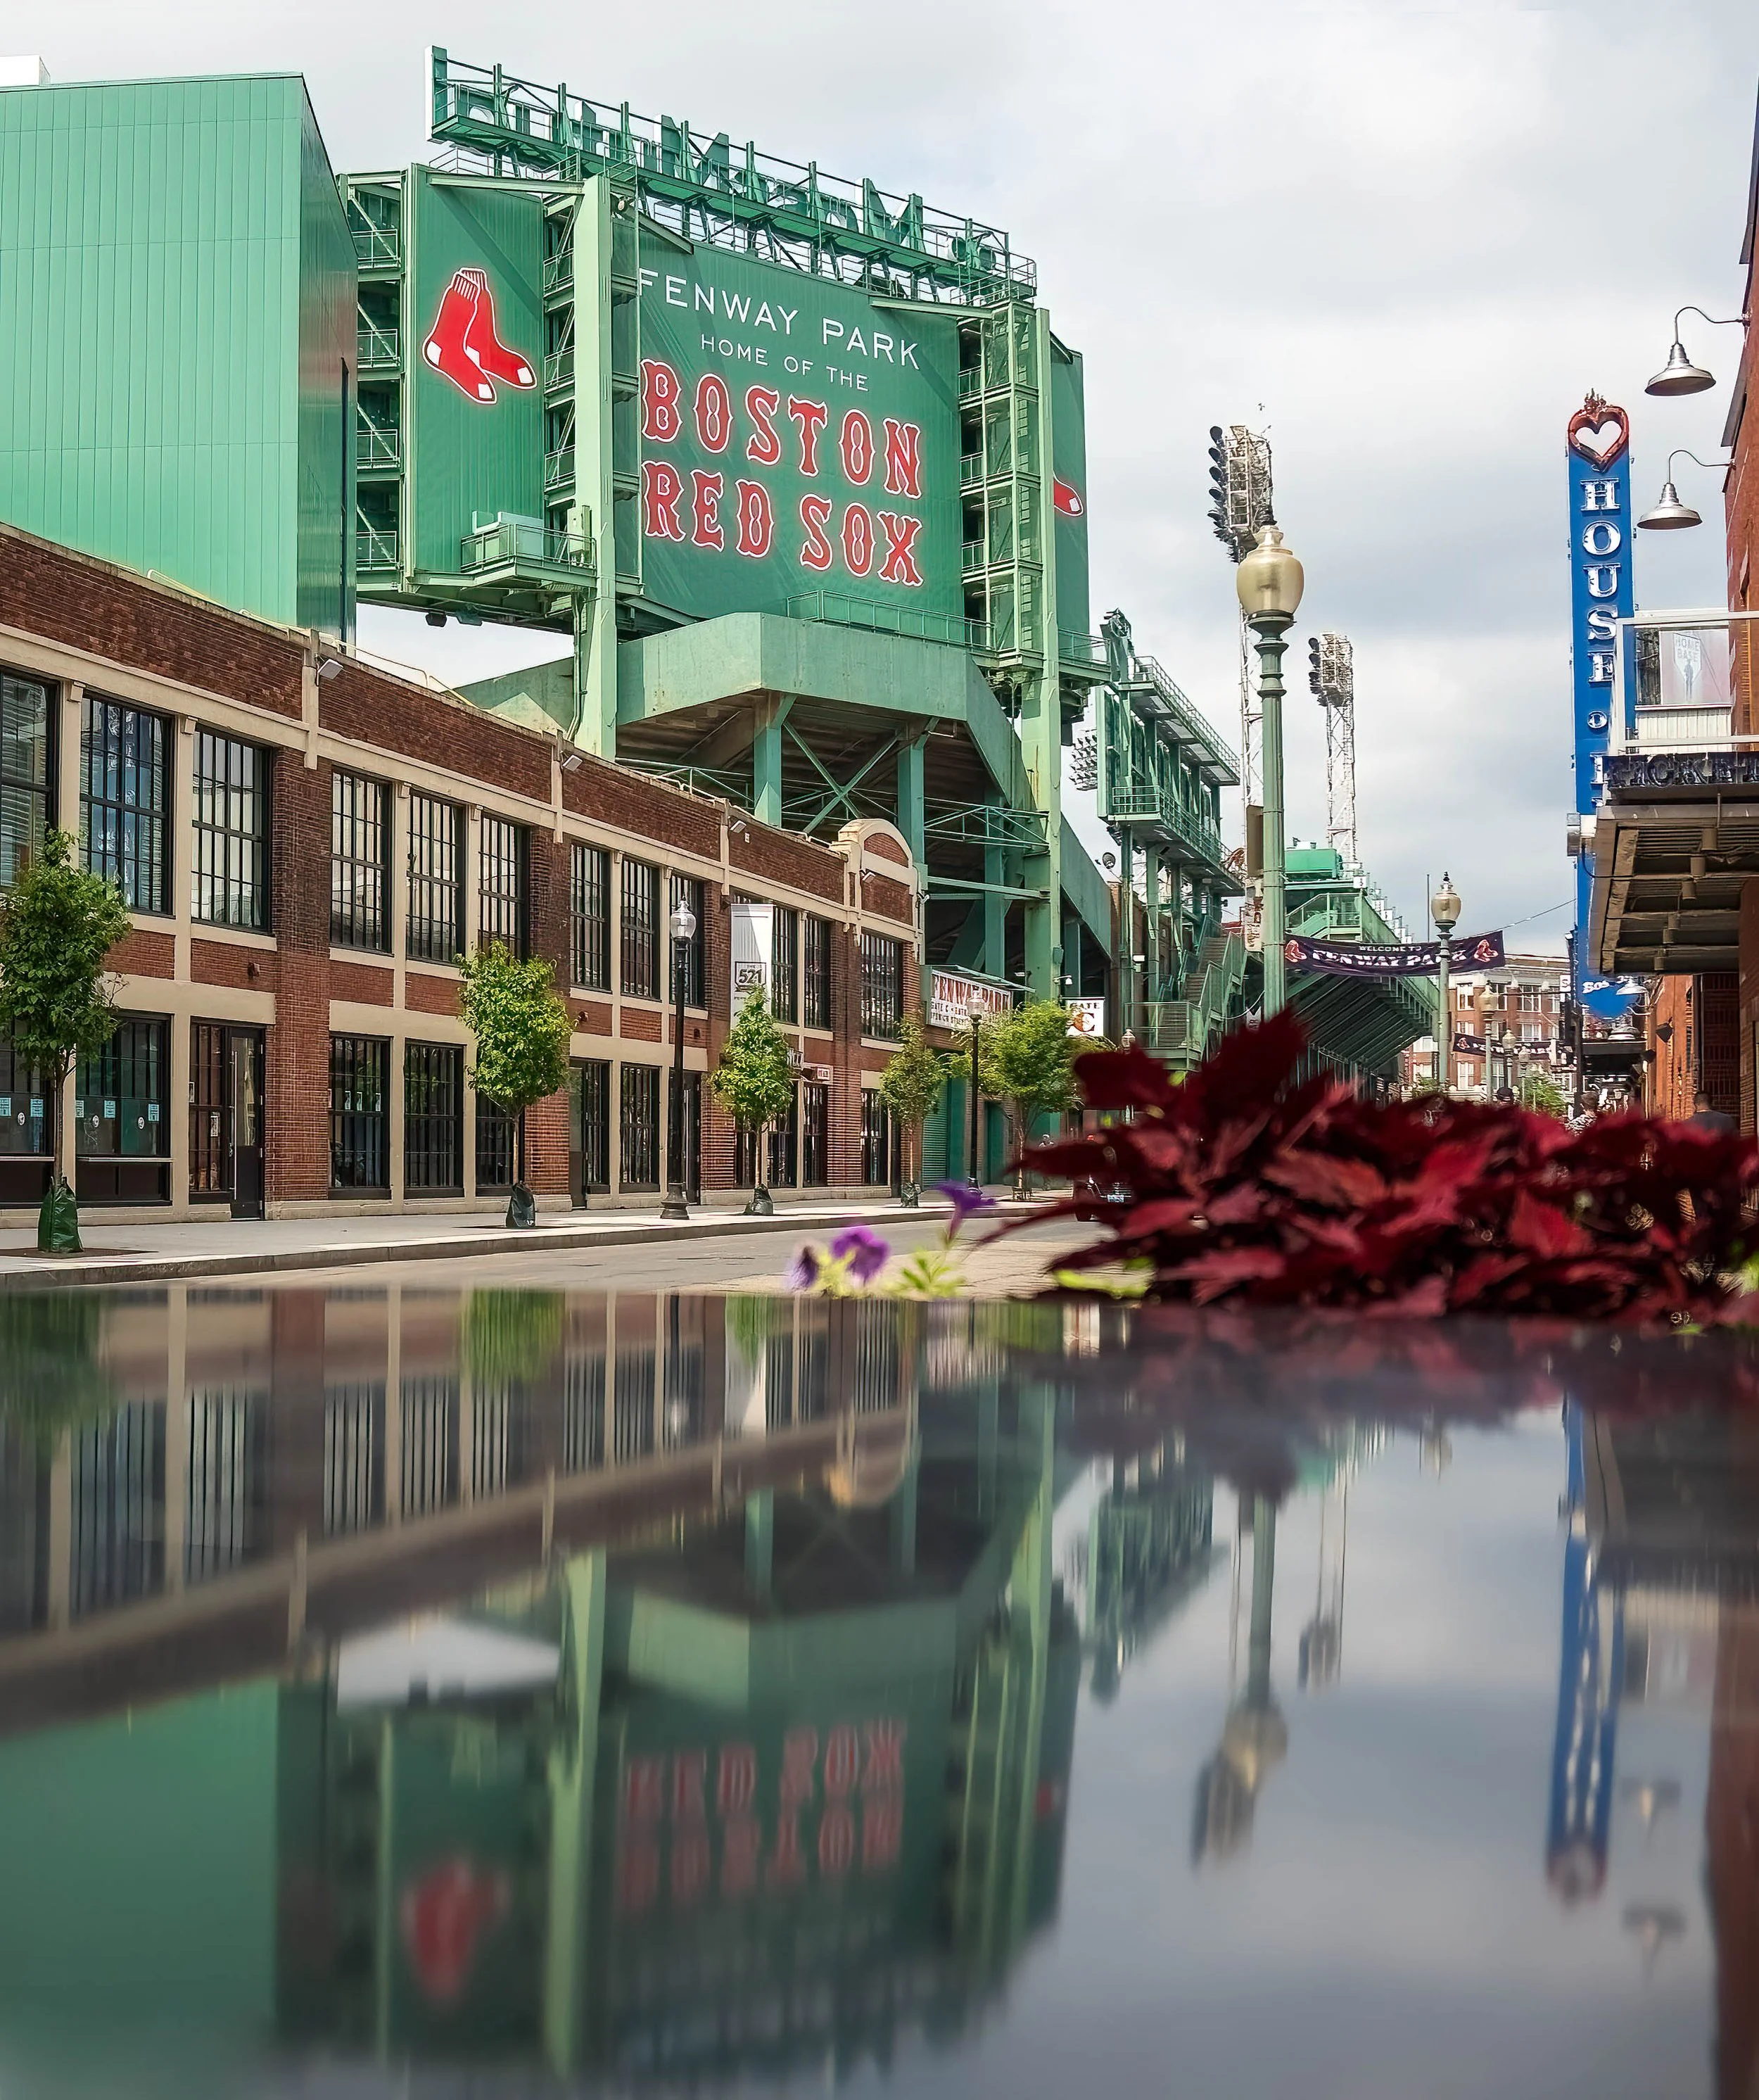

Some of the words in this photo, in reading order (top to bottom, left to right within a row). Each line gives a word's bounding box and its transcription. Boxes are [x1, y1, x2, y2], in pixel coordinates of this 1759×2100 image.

[639, 268, 799, 335] FENWAY
[822, 317, 920, 370] PARK
[700, 333, 769, 367] HOME
[785, 356, 812, 376] OF
[826, 367, 870, 392] THE
[640, 358, 922, 500] BOSTON
[641, 460, 775, 559] RED
[799, 493, 924, 588] SOX
[1580, 478, 1621, 683] HOUSE
[738, 969, 763, 984] 521
[1312, 949, 1403, 967] FENWAY
[1407, 949, 1468, 966] PAK
[1072, 1012, 1096, 1032] C
